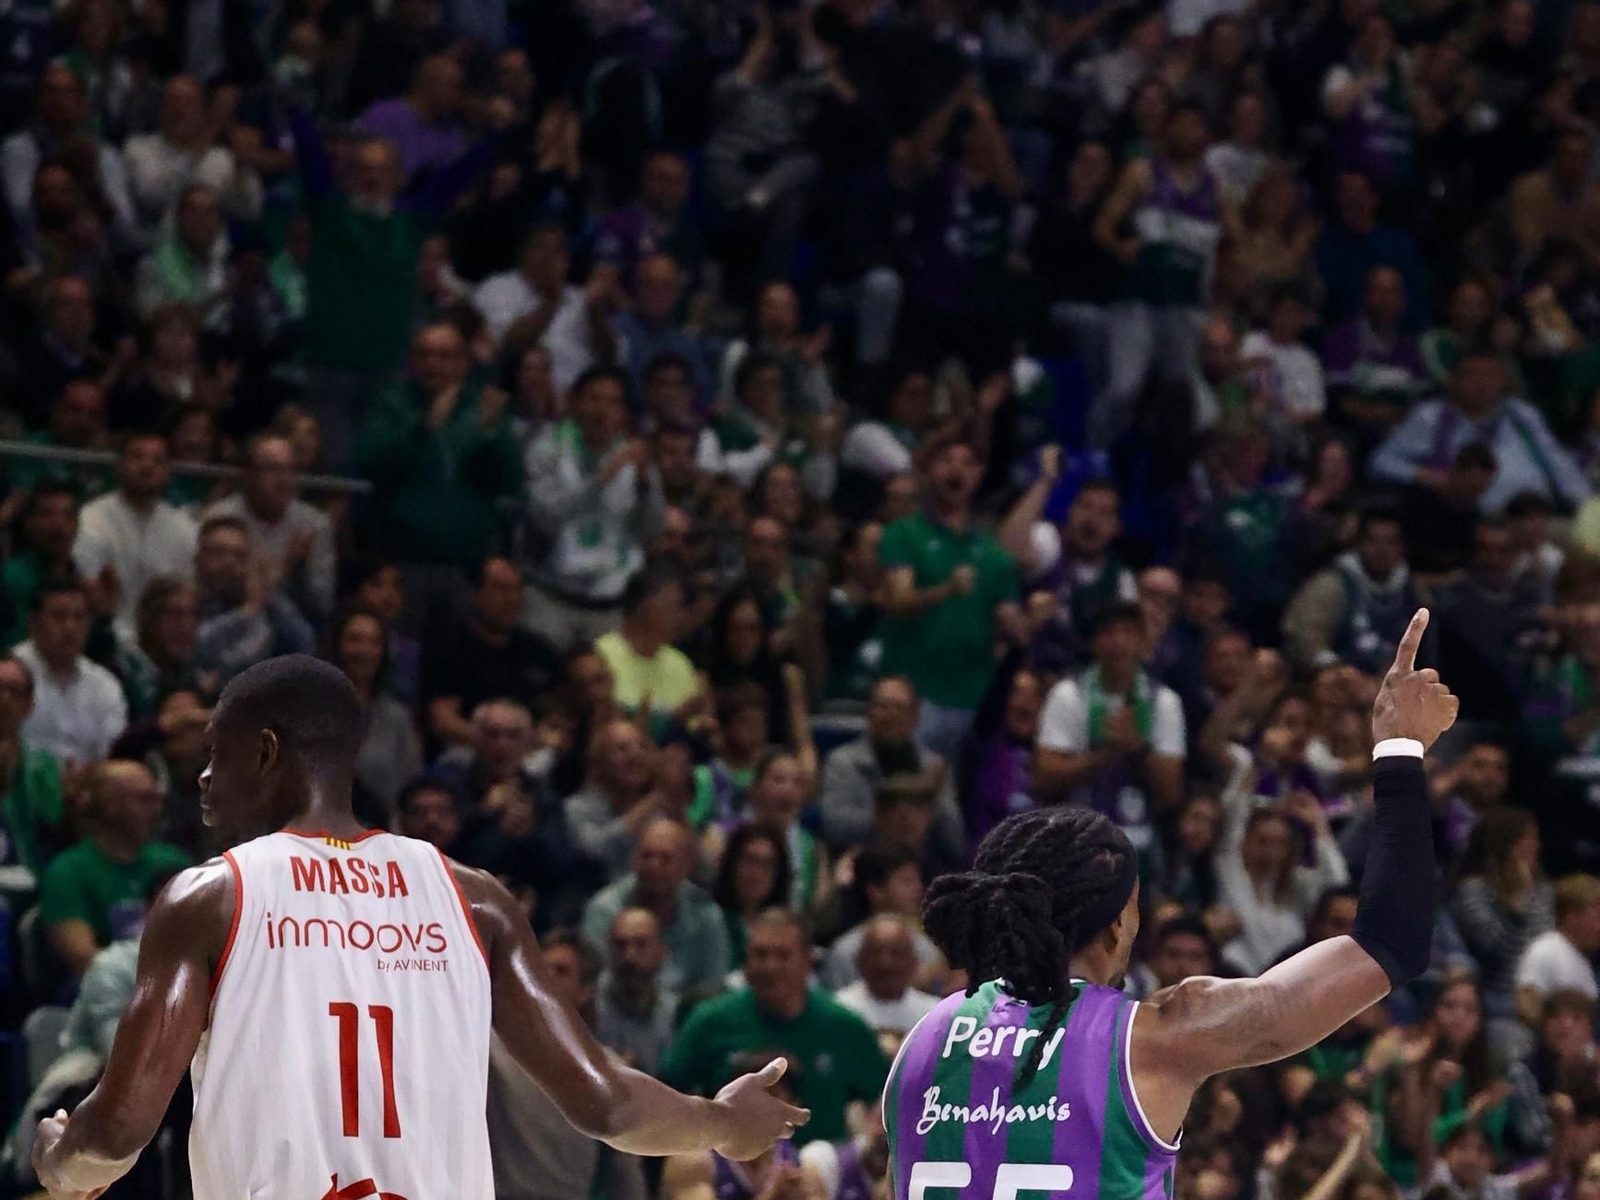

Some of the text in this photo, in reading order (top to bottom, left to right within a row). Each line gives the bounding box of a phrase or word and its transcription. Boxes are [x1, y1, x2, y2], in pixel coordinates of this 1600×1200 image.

[290, 856, 409, 898] MASSA
[266, 912, 447, 953] inmoovs
[393, 958, 449, 972] AVINENT
[942, 1015, 1066, 1071] Perry
[328, 1002, 402, 1139] 11
